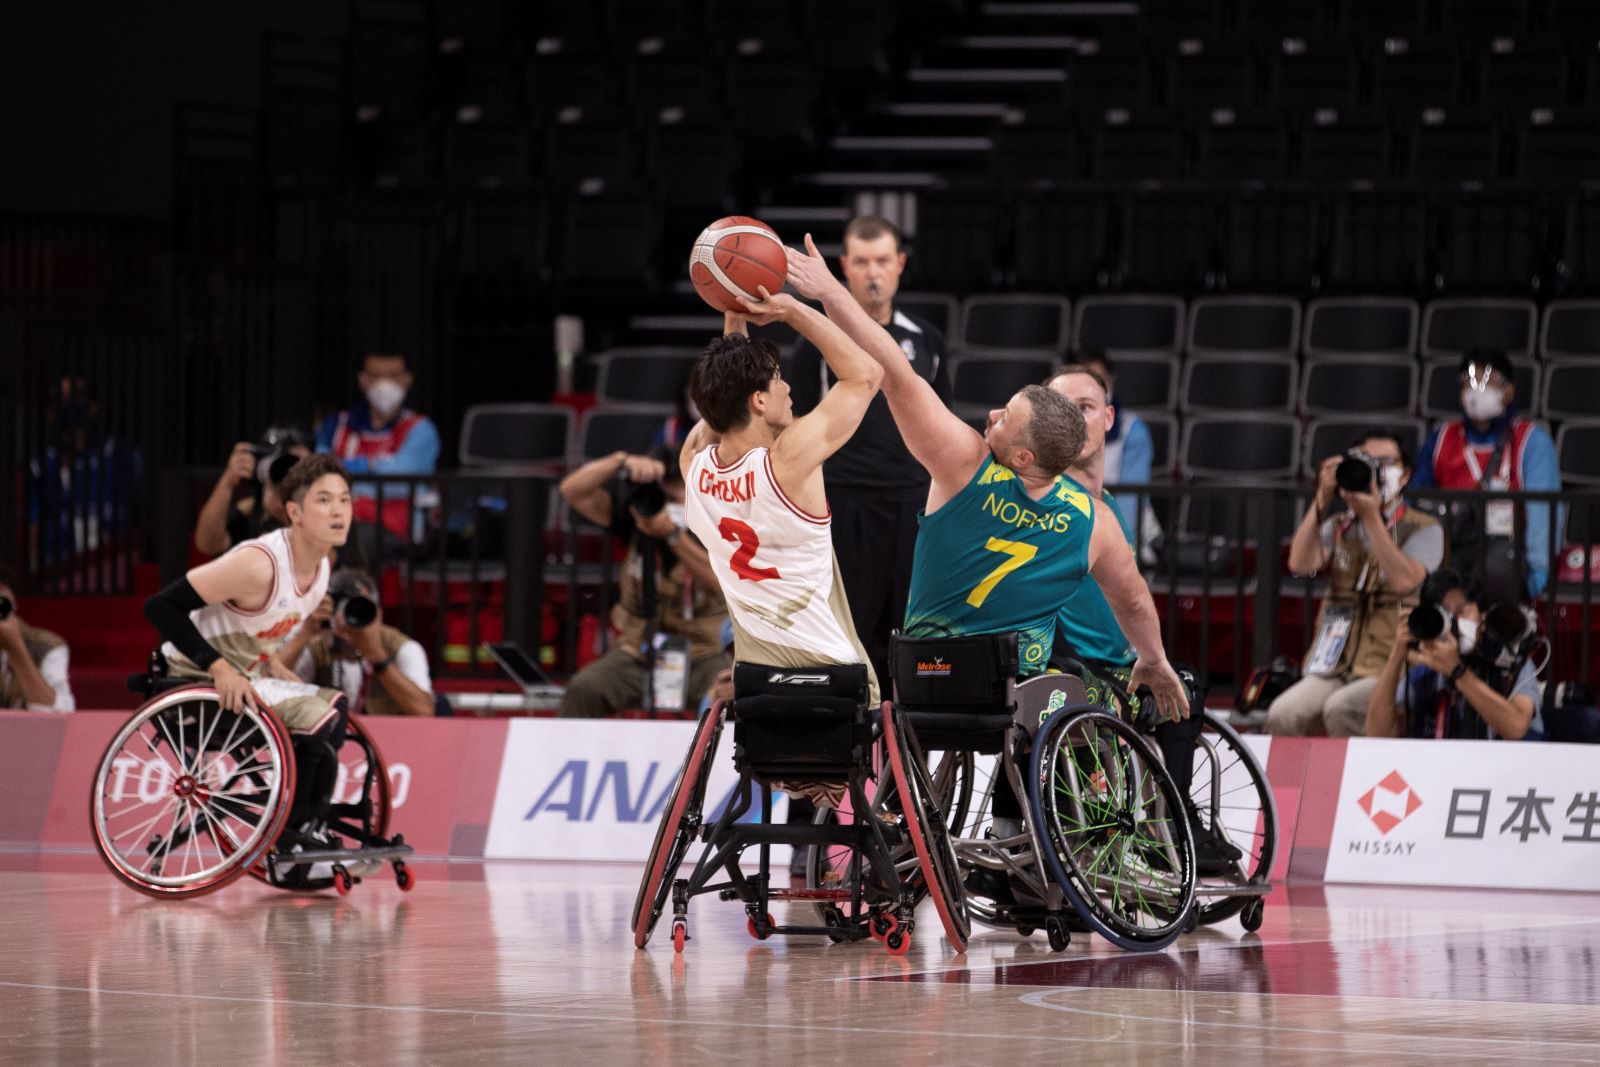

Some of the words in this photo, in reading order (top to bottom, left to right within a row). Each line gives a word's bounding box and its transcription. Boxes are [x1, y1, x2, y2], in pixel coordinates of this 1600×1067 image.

[982, 492, 1071, 533] NORRIS
[719, 517, 782, 582] 2
[966, 536, 1038, 608] 7
[523, 760, 686, 823] AN
[1348, 839, 1416, 856] NISSAY
